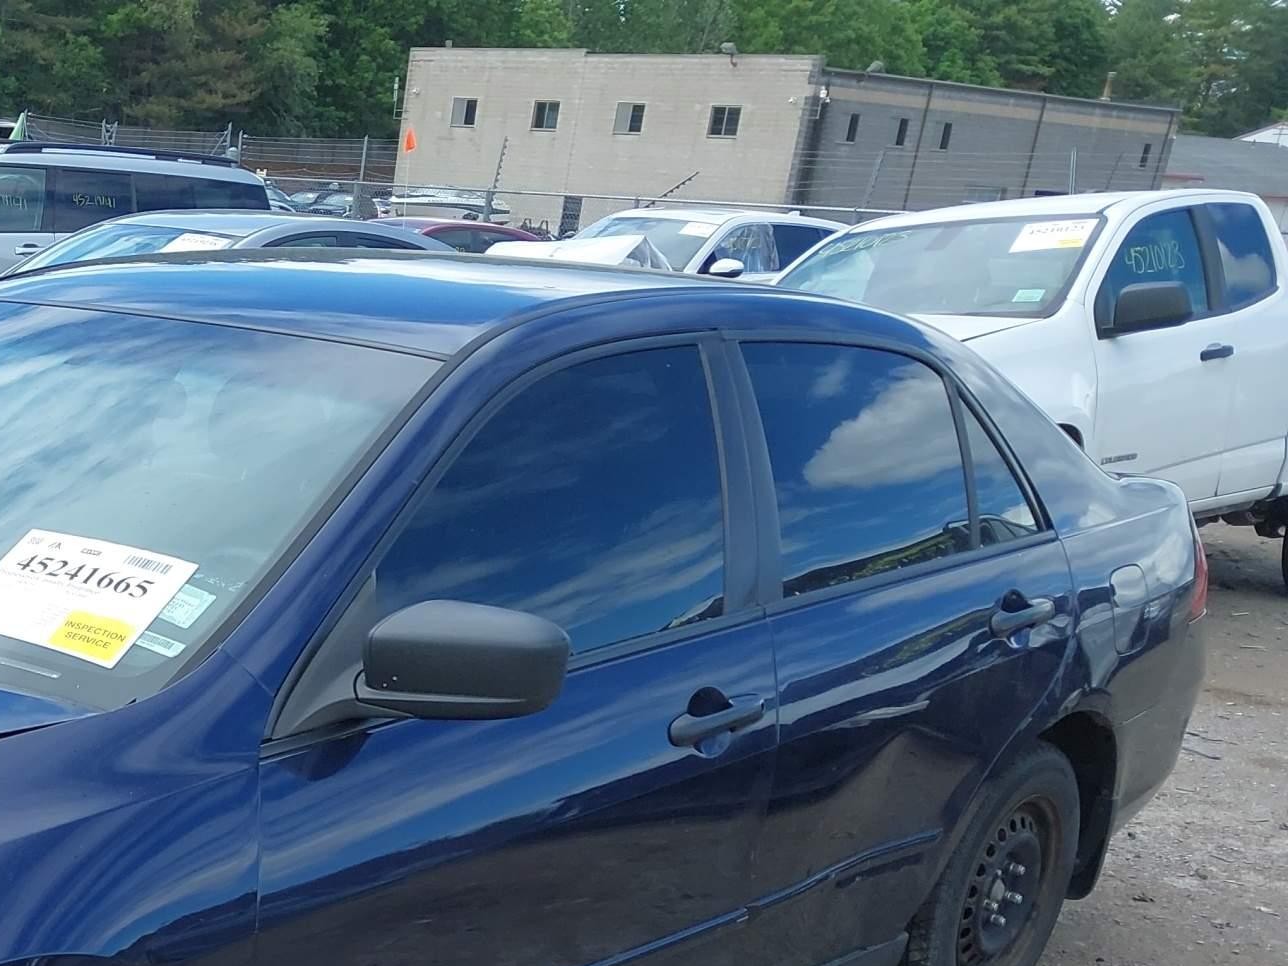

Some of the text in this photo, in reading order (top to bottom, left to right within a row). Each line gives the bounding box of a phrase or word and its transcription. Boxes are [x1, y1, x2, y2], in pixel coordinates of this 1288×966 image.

[15, 553, 155, 599] 45241665
[64, 620, 127, 643] INSPECTION
[64, 631, 112, 649] SERVICE
